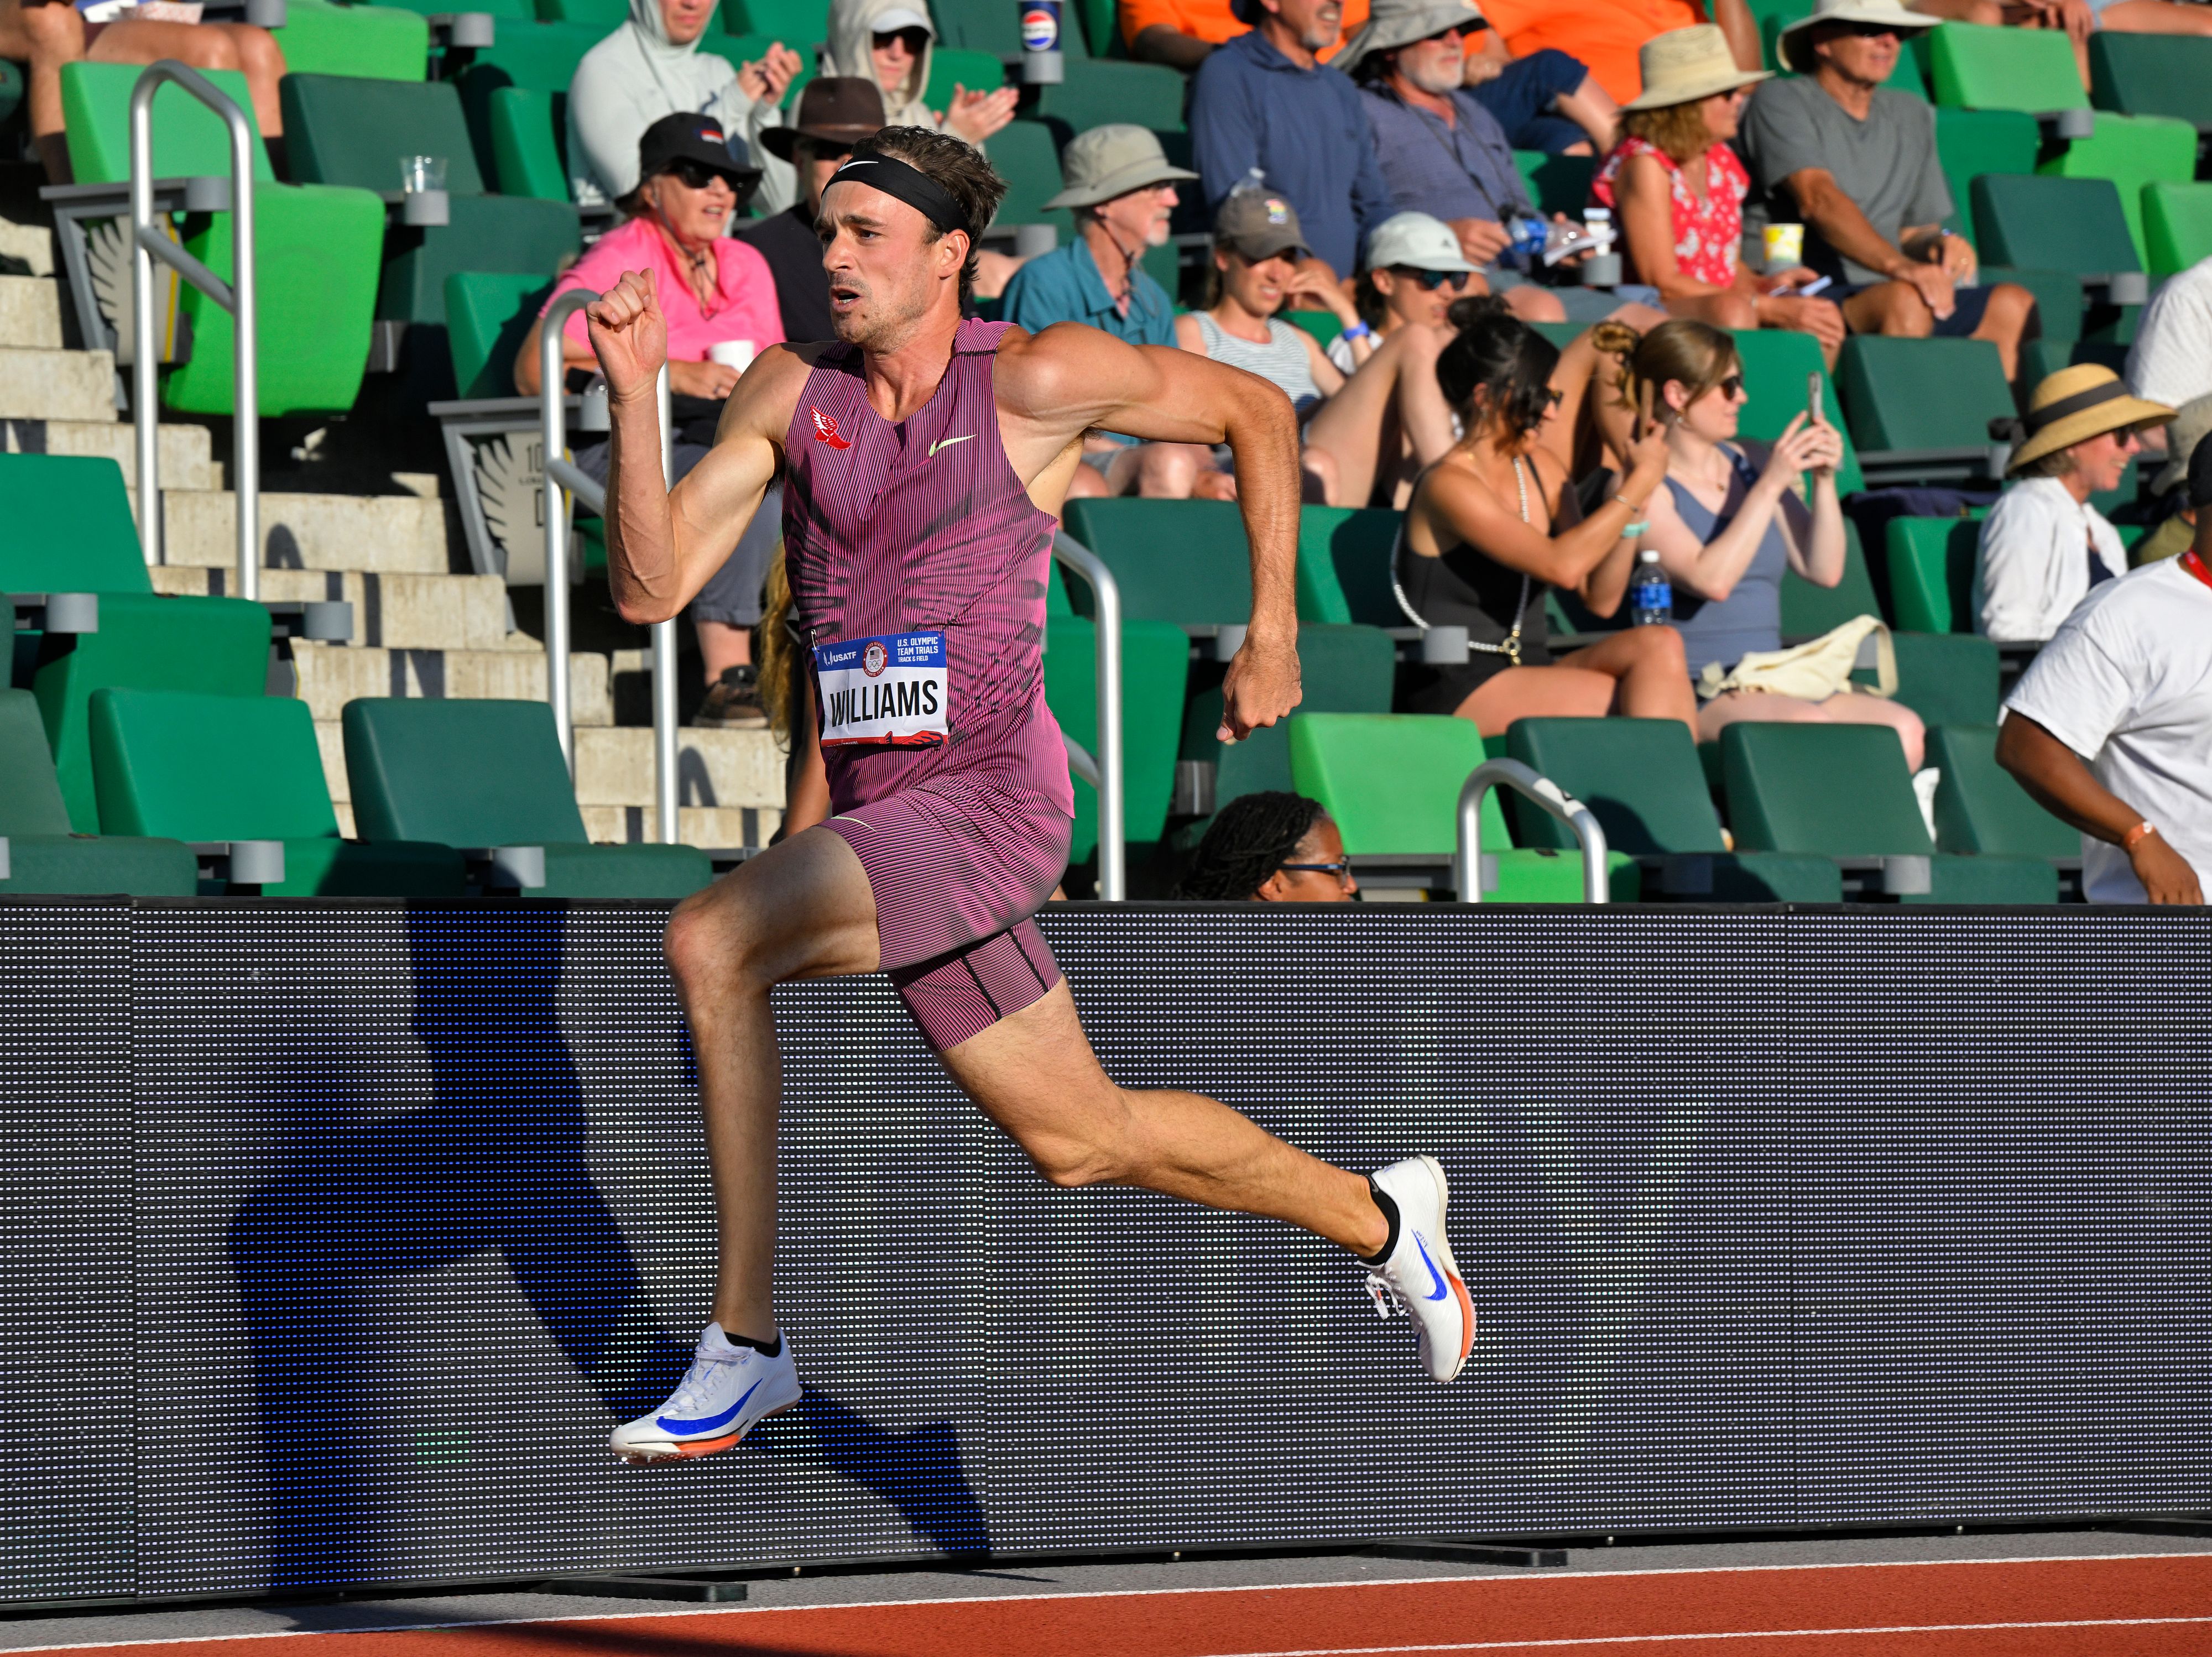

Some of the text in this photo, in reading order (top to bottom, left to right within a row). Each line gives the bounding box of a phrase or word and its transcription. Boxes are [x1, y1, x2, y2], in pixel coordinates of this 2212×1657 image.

[898, 636, 938, 647] U.S. OLYMPIC
[897, 645, 938, 656] TEAM TRIALS
[833, 651, 857, 662] USATF
[830, 679, 938, 728] WILLIAMS
